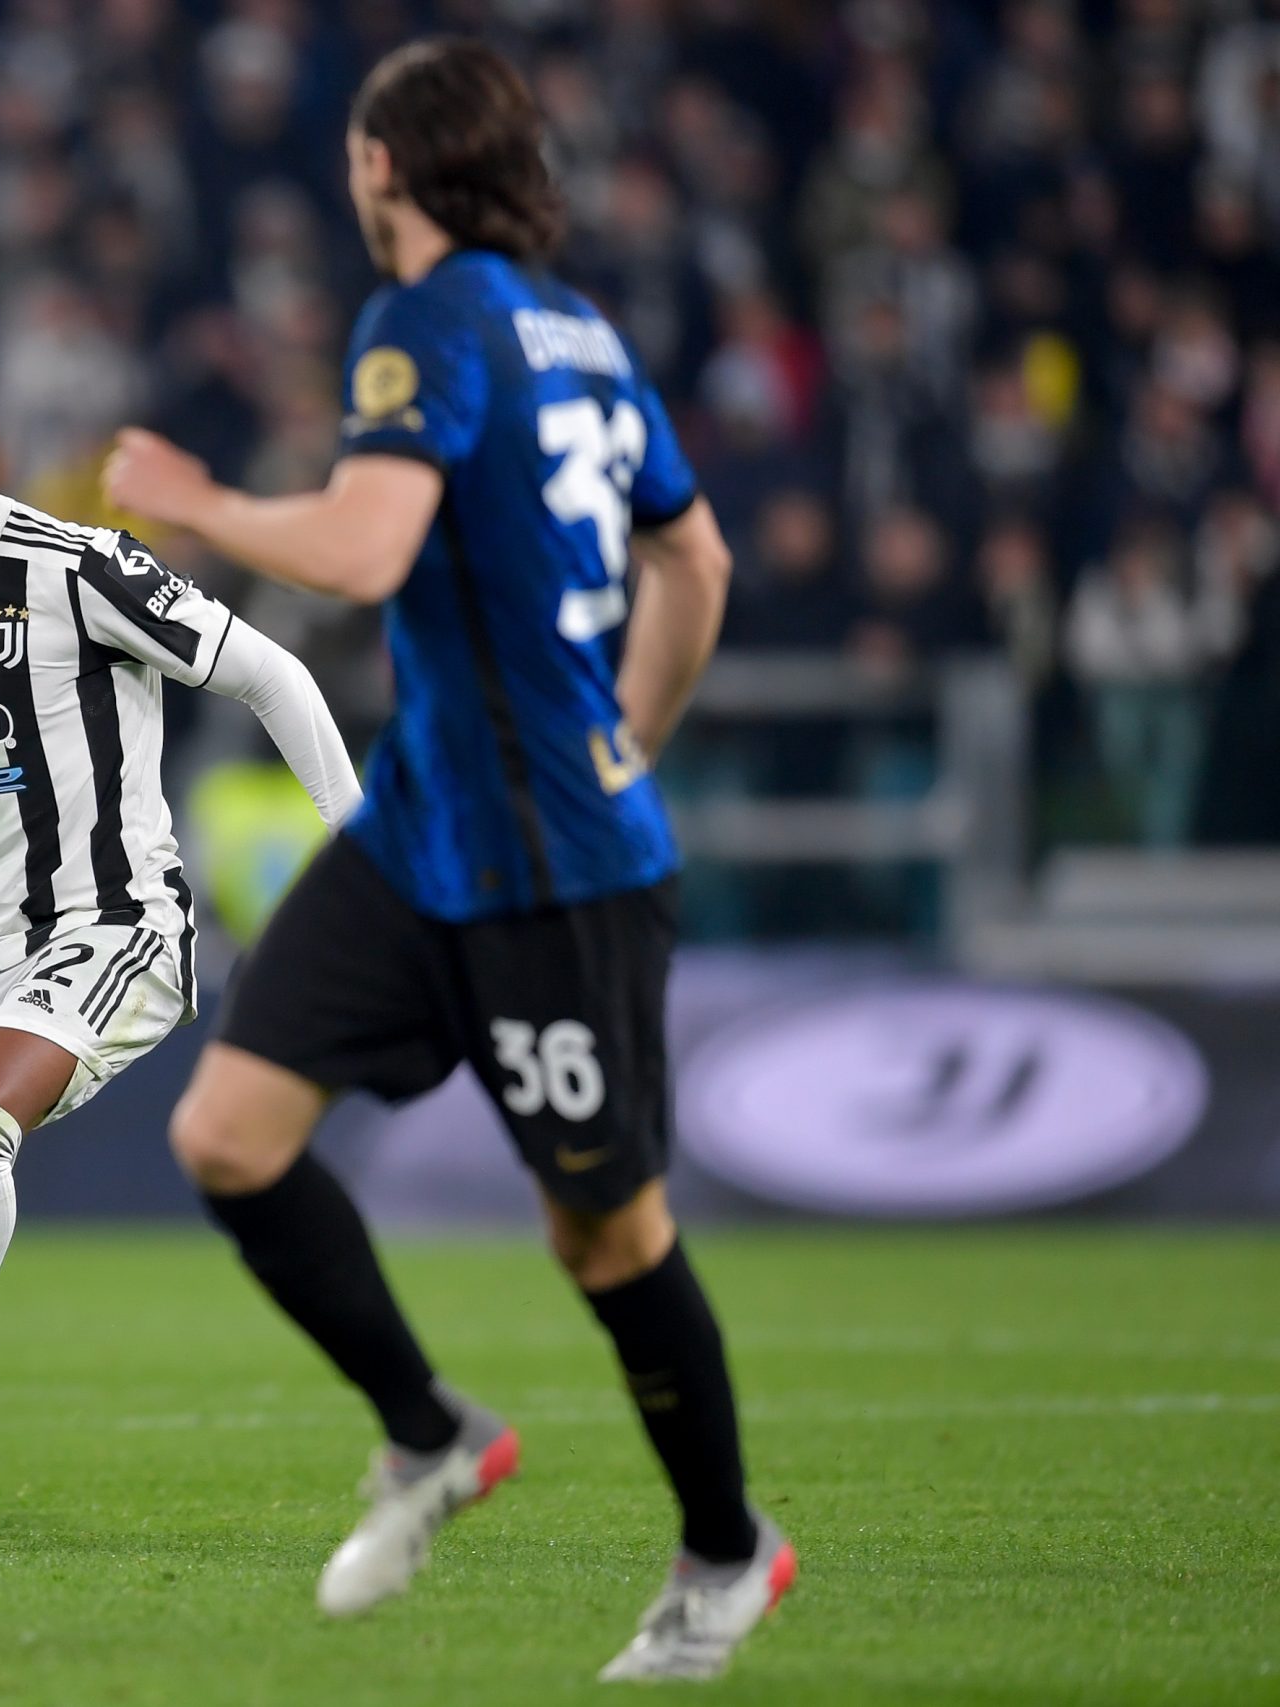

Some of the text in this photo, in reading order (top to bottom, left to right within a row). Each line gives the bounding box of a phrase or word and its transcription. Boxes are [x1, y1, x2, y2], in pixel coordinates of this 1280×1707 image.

[146, 575, 187, 618] Bitg
[32, 943, 95, 988] 2
[17, 995, 55, 1014] adidas
[489, 1017, 606, 1122] 36
